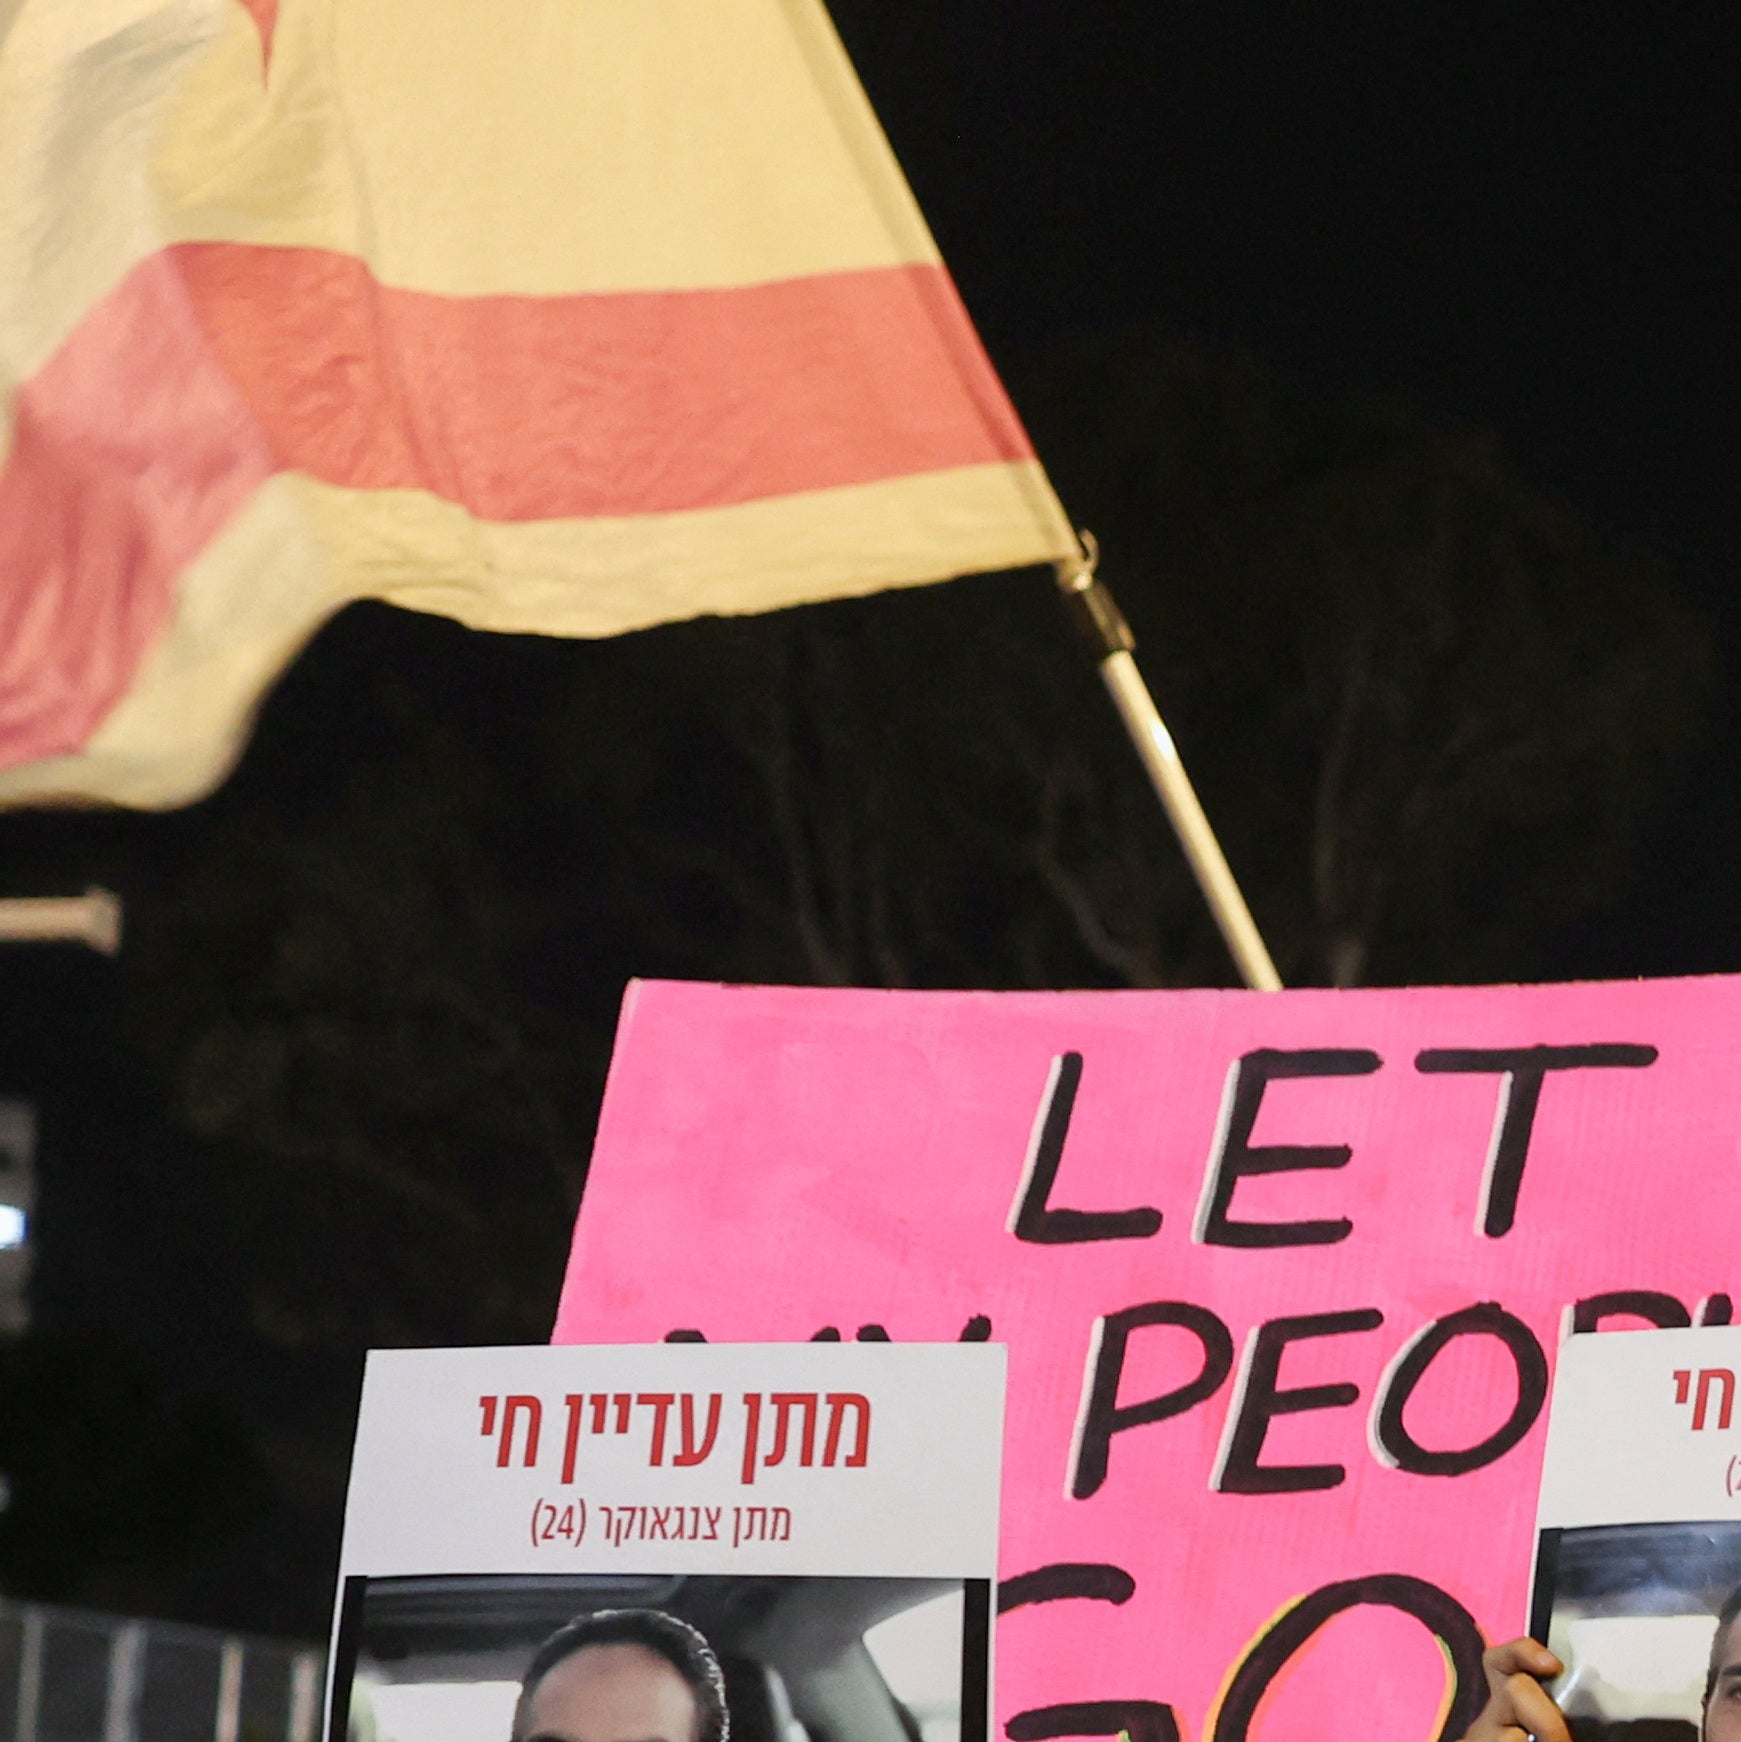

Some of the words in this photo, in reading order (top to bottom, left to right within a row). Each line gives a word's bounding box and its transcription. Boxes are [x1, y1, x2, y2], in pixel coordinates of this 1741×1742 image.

[1005, 1042, 1660, 1248] LET
[478, 1395, 543, 1468] חי
[1673, 1369, 1736, 1431] חי
[560, 1393, 723, 1485] עדיין
[739, 1393, 871, 1485] מתן
[530, 1497, 587, 1548] (24)
[599, 1506, 721, 1548] צנגאוקר
[733, 1506, 791, 1548] מתן
